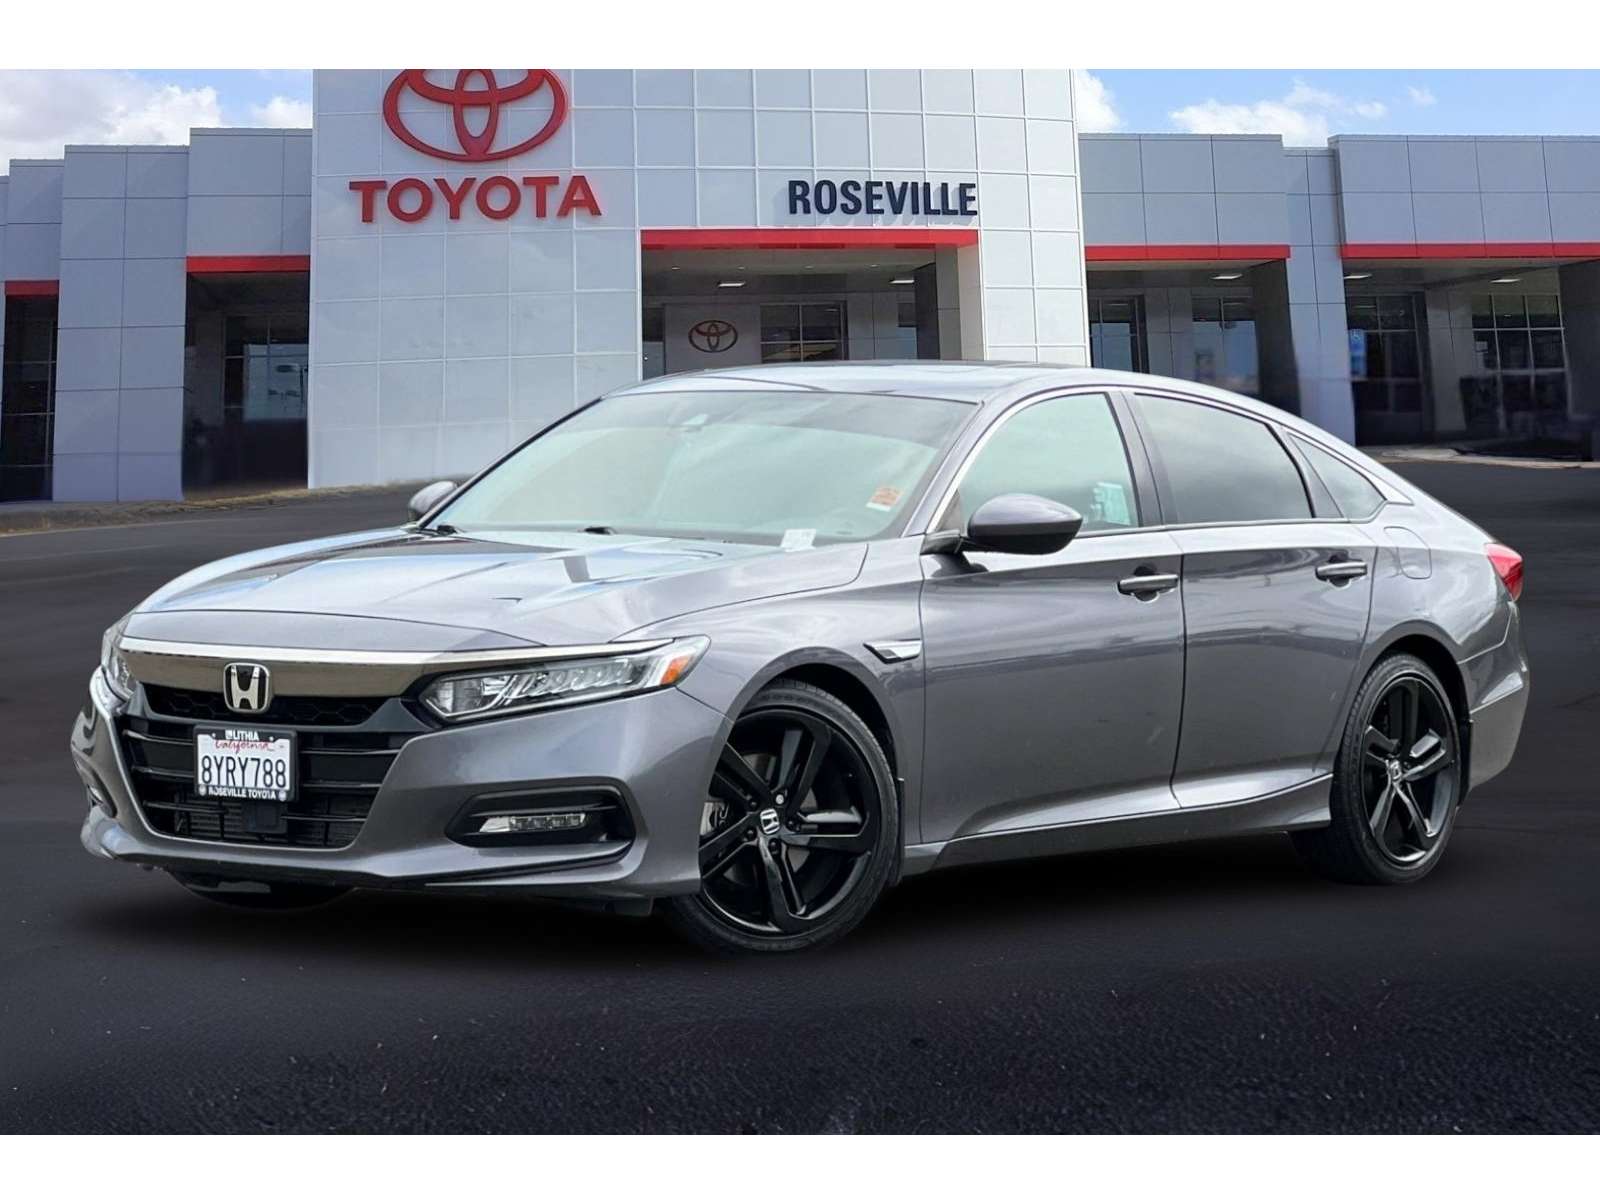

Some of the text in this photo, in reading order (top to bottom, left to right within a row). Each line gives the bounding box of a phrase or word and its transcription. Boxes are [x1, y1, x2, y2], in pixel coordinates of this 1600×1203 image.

[349, 175, 602, 223] TOYOTA
[788, 180, 978, 217] ROSEVILLE
[202, 755, 286, 788] 8YRY788
[208, 786, 276, 800] ROSEVILLE TOYOTA
